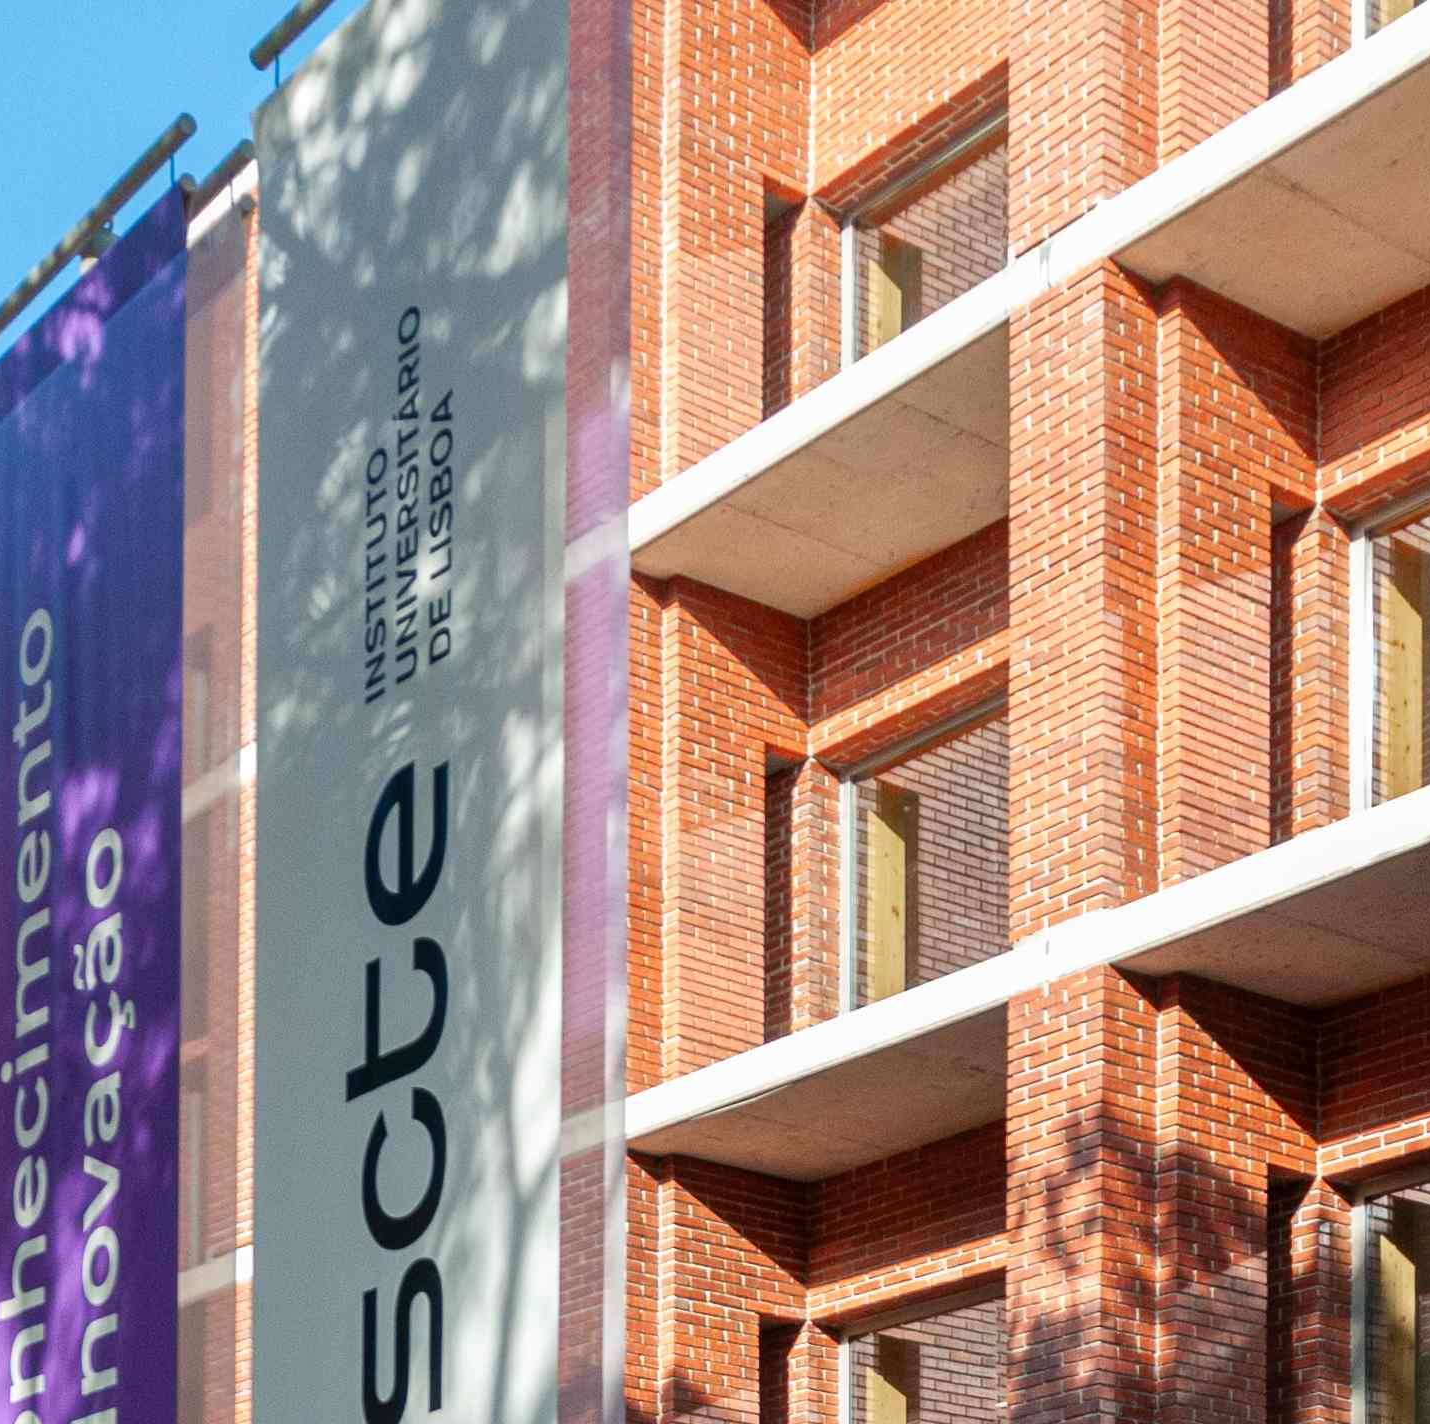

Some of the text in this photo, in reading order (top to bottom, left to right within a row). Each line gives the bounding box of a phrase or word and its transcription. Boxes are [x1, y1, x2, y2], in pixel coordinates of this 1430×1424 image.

[365, 447, 388, 704] INSTITUTO
[393, 306, 421, 685] UNIVERSITÁRIO
[429, 388, 454, 665] DE LISBOA
